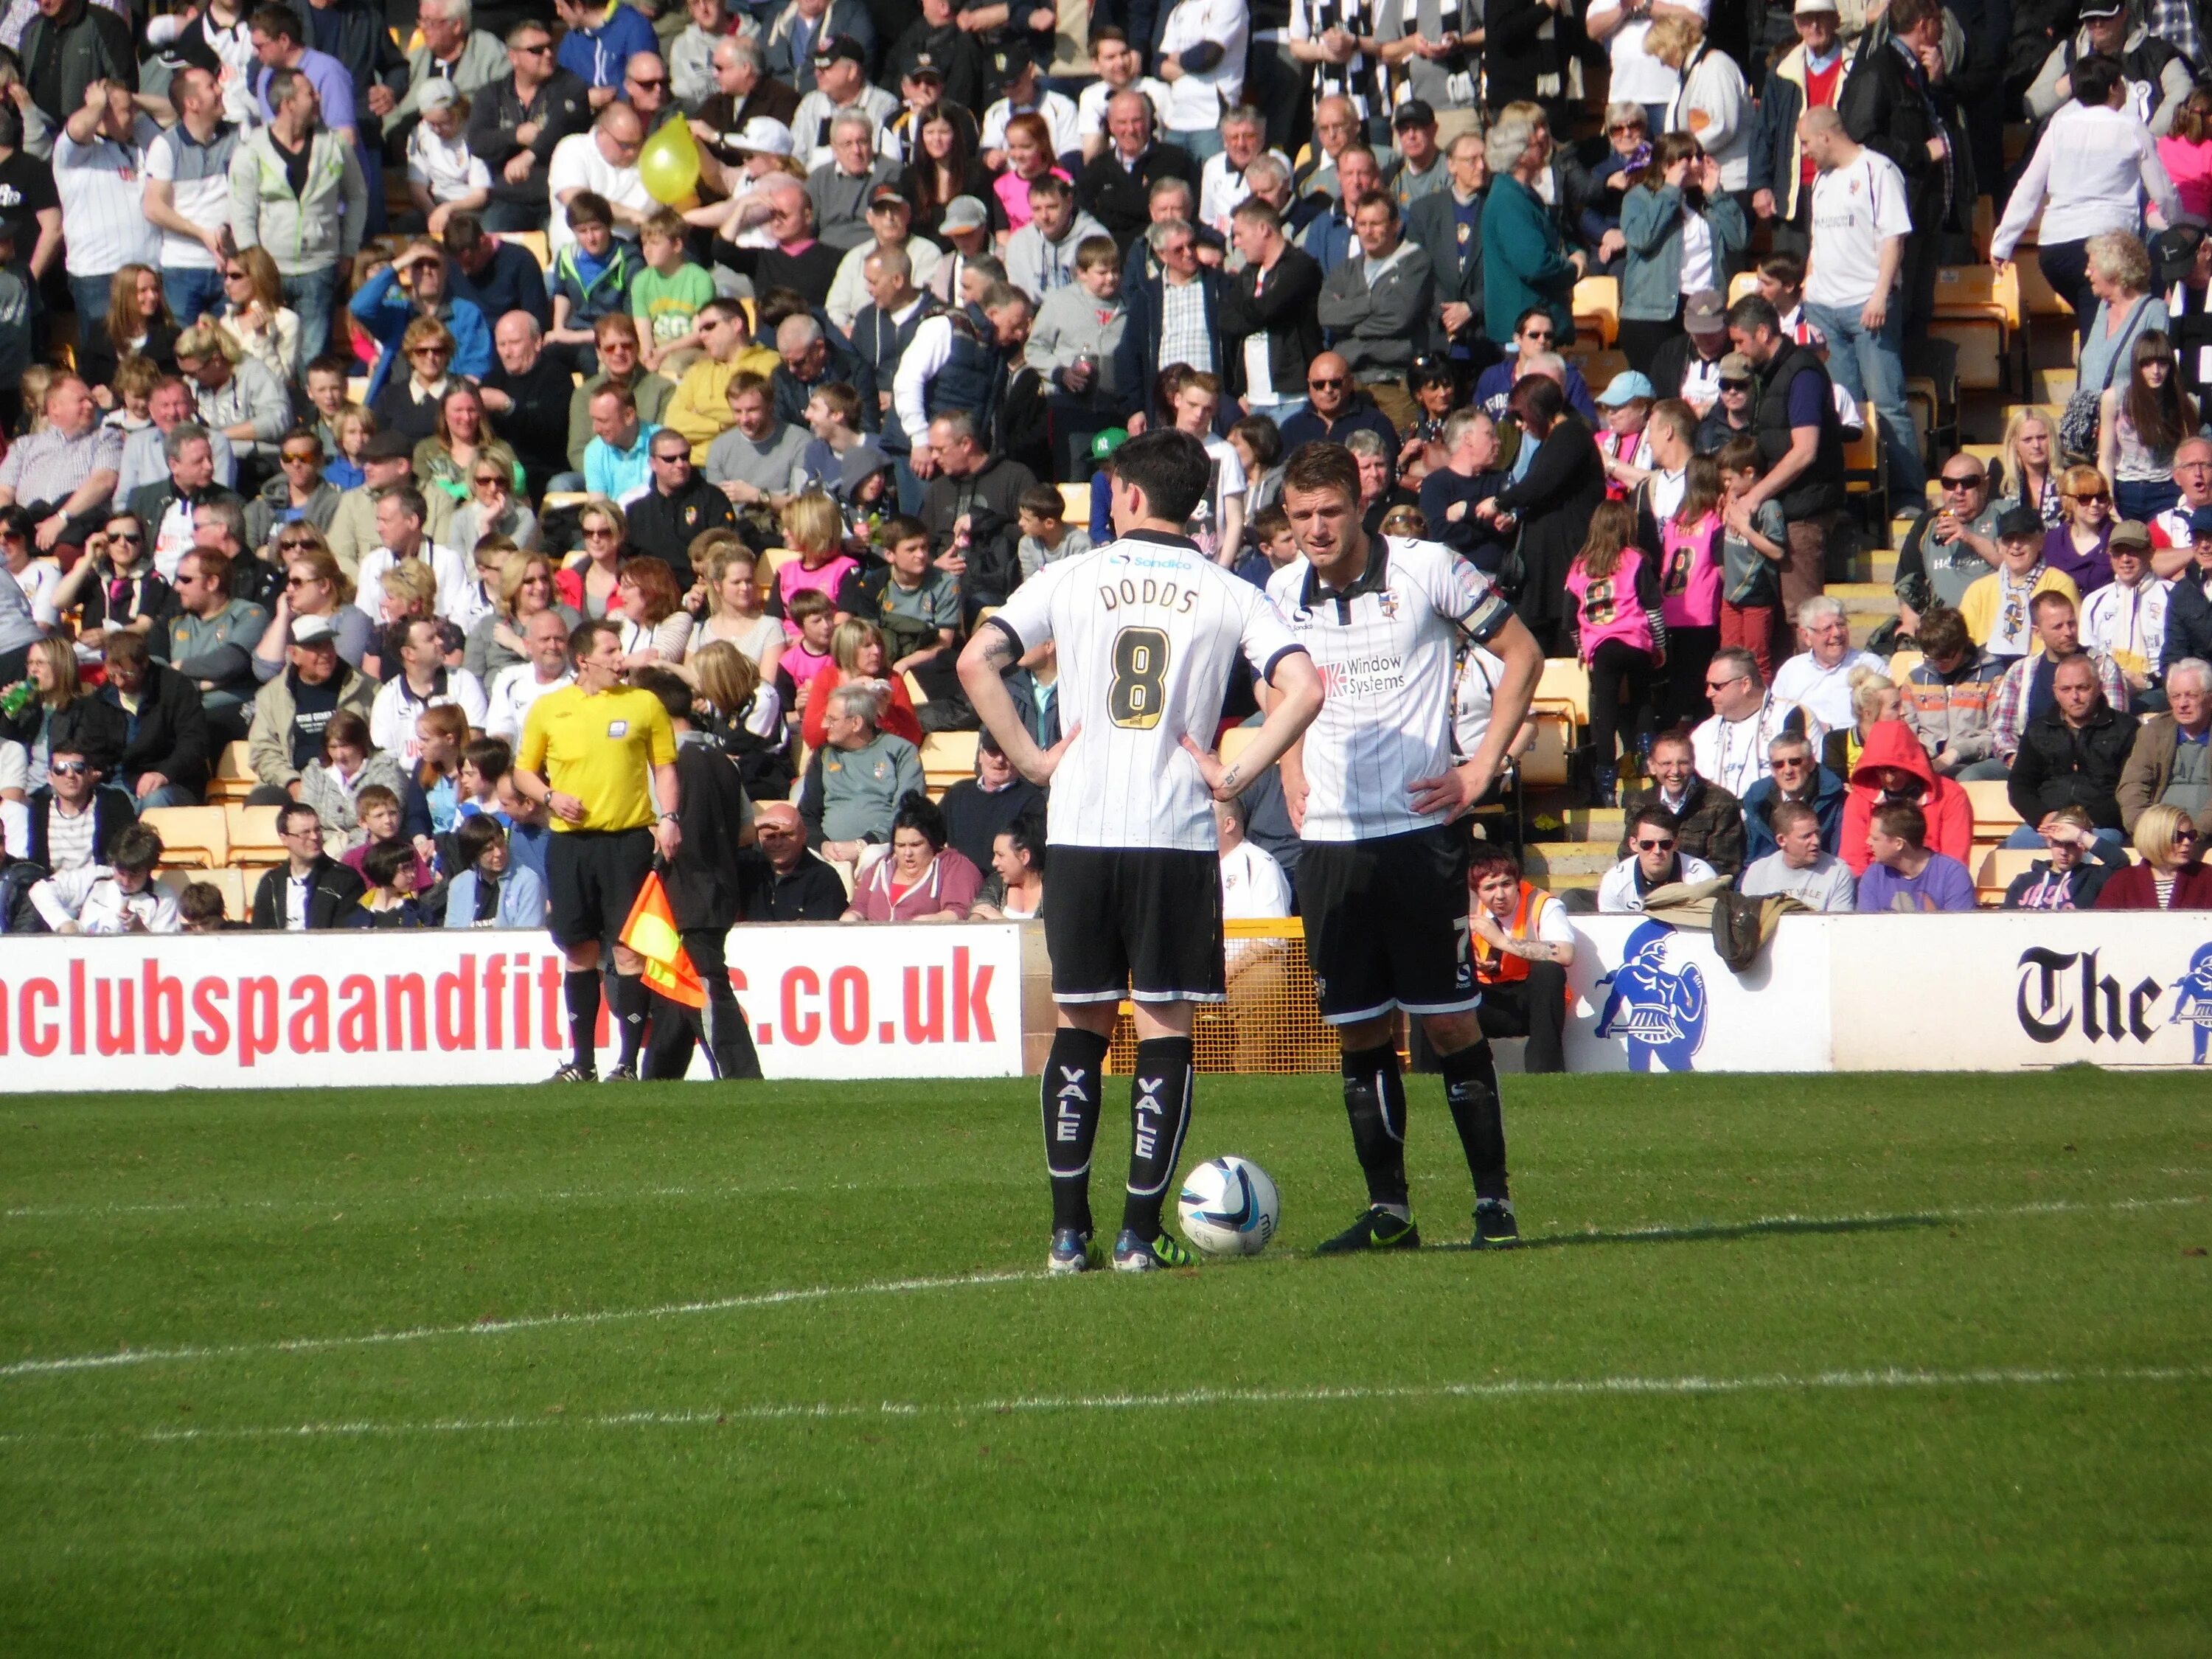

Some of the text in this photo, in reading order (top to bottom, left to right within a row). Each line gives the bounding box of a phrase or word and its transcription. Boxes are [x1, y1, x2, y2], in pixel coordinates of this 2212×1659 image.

[1099, 579, 1199, 613] DODDS
[1107, 625, 1170, 730] 8
[1347, 655, 1402, 675] Window
[1350, 674, 1405, 700] Systems
[2017, 946, 2163, 1044] The
[1056, 1065, 1088, 1141] VALE
[1135, 1078, 1163, 1159] VALE
